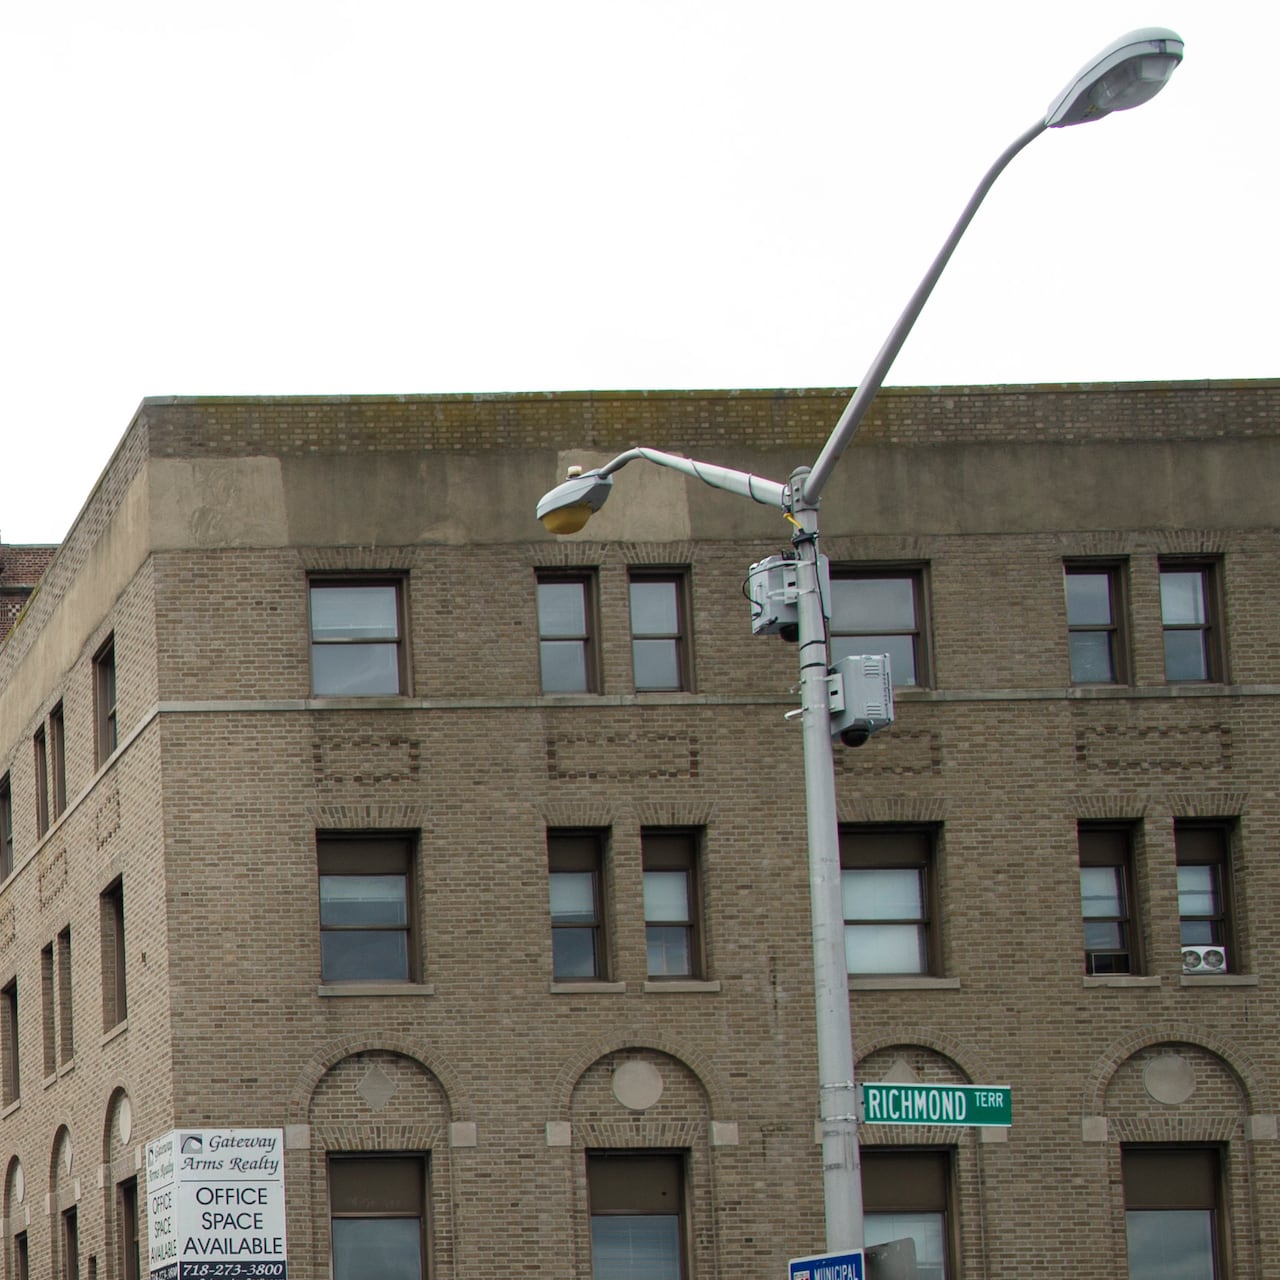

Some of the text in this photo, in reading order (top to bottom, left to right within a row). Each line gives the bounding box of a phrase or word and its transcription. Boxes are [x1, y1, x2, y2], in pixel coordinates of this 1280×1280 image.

[868, 1088, 1004, 1120] RICHMOND TERR
[208, 1135, 278, 1154] Gateway
[181, 1156, 224, 1171] Arms
[229, 1157, 280, 1176] Realty
[151, 1191, 173, 1215] OFFICE
[196, 1187, 268, 1206] OFFICE
[154, 1216, 172, 1240] SPACE
[201, 1212, 263, 1230] SPACE
[183, 1237, 283, 1255] AVAILABLE
[182, 1263, 283, 1277] 718-273-3800
